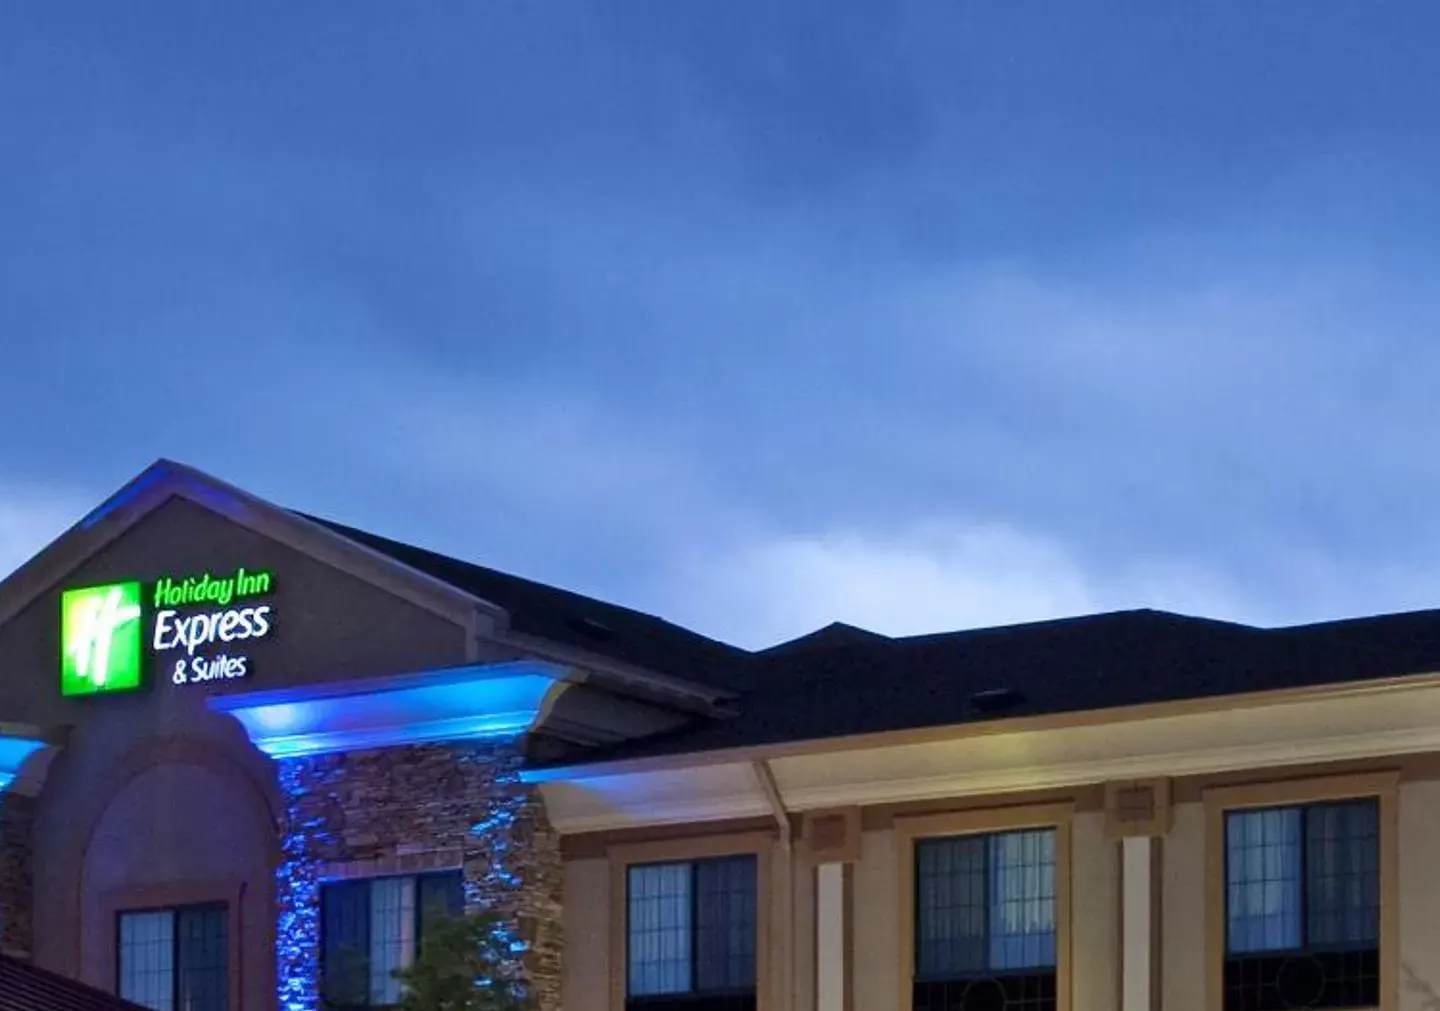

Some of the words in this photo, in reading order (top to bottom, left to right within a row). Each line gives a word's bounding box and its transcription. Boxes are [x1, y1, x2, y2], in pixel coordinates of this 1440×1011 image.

[154, 574, 234, 606] Holiday
[237, 568, 270, 595] Inn
[153, 606, 270, 654] Express
[172, 660, 187, 684] &
[192, 655, 247, 682] Suites
